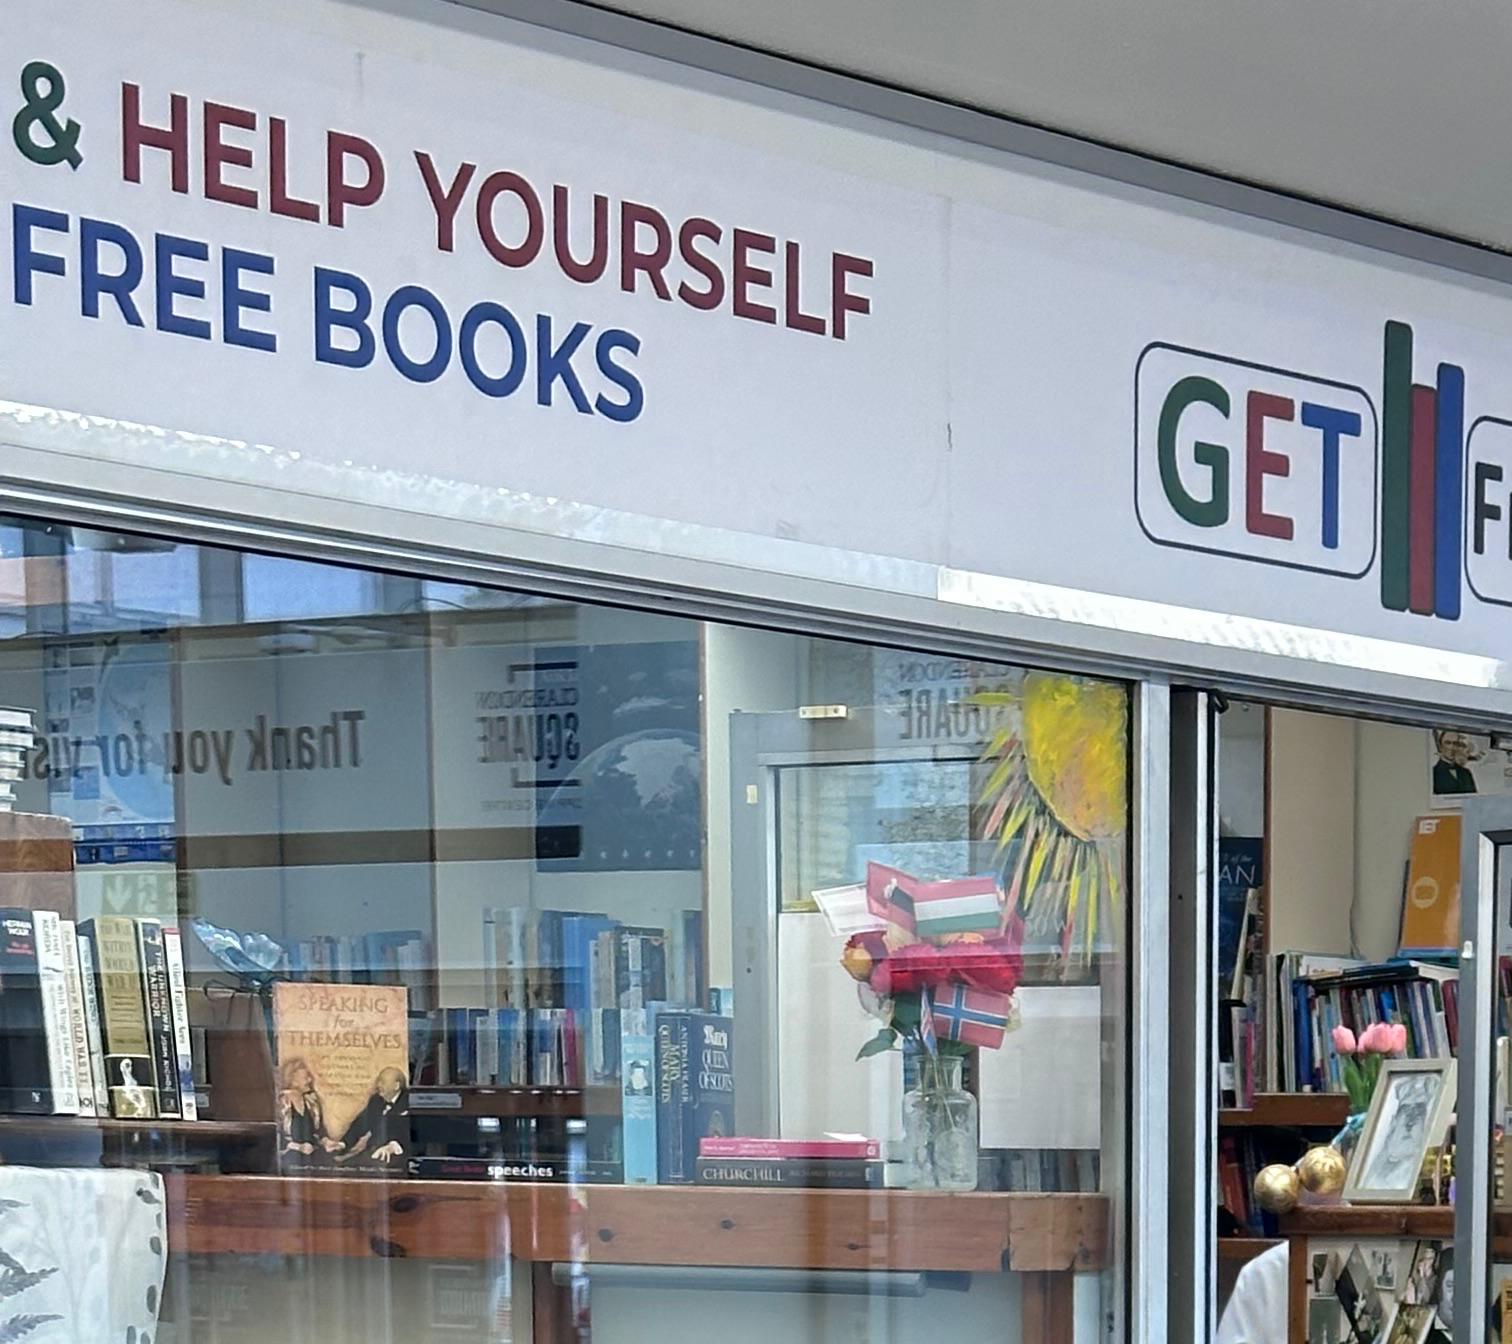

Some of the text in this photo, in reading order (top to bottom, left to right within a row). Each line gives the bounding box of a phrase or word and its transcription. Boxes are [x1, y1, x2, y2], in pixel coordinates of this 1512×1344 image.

[12, 61, 876, 341] & HELP YOURSELF
[12, 204, 645, 424] FREE BOOKS
[1157, 376, 1362, 549] GET
[1219, 864, 1256, 884] AN
[148, 965, 161, 1018] WARRIOR
[158, 974, 170, 1032] UNKNOWN
[299, 996, 388, 1015] SPEAKING
[72, 1008, 86, 1044] WORLD
[334, 1016, 354, 1030] for
[288, 1031, 401, 1050] THEMSELVES
[702, 1049, 730, 1074] QUEEN
[487, 1164, 554, 1181] speeches
[702, 1166, 785, 1182] CHURCHILL
